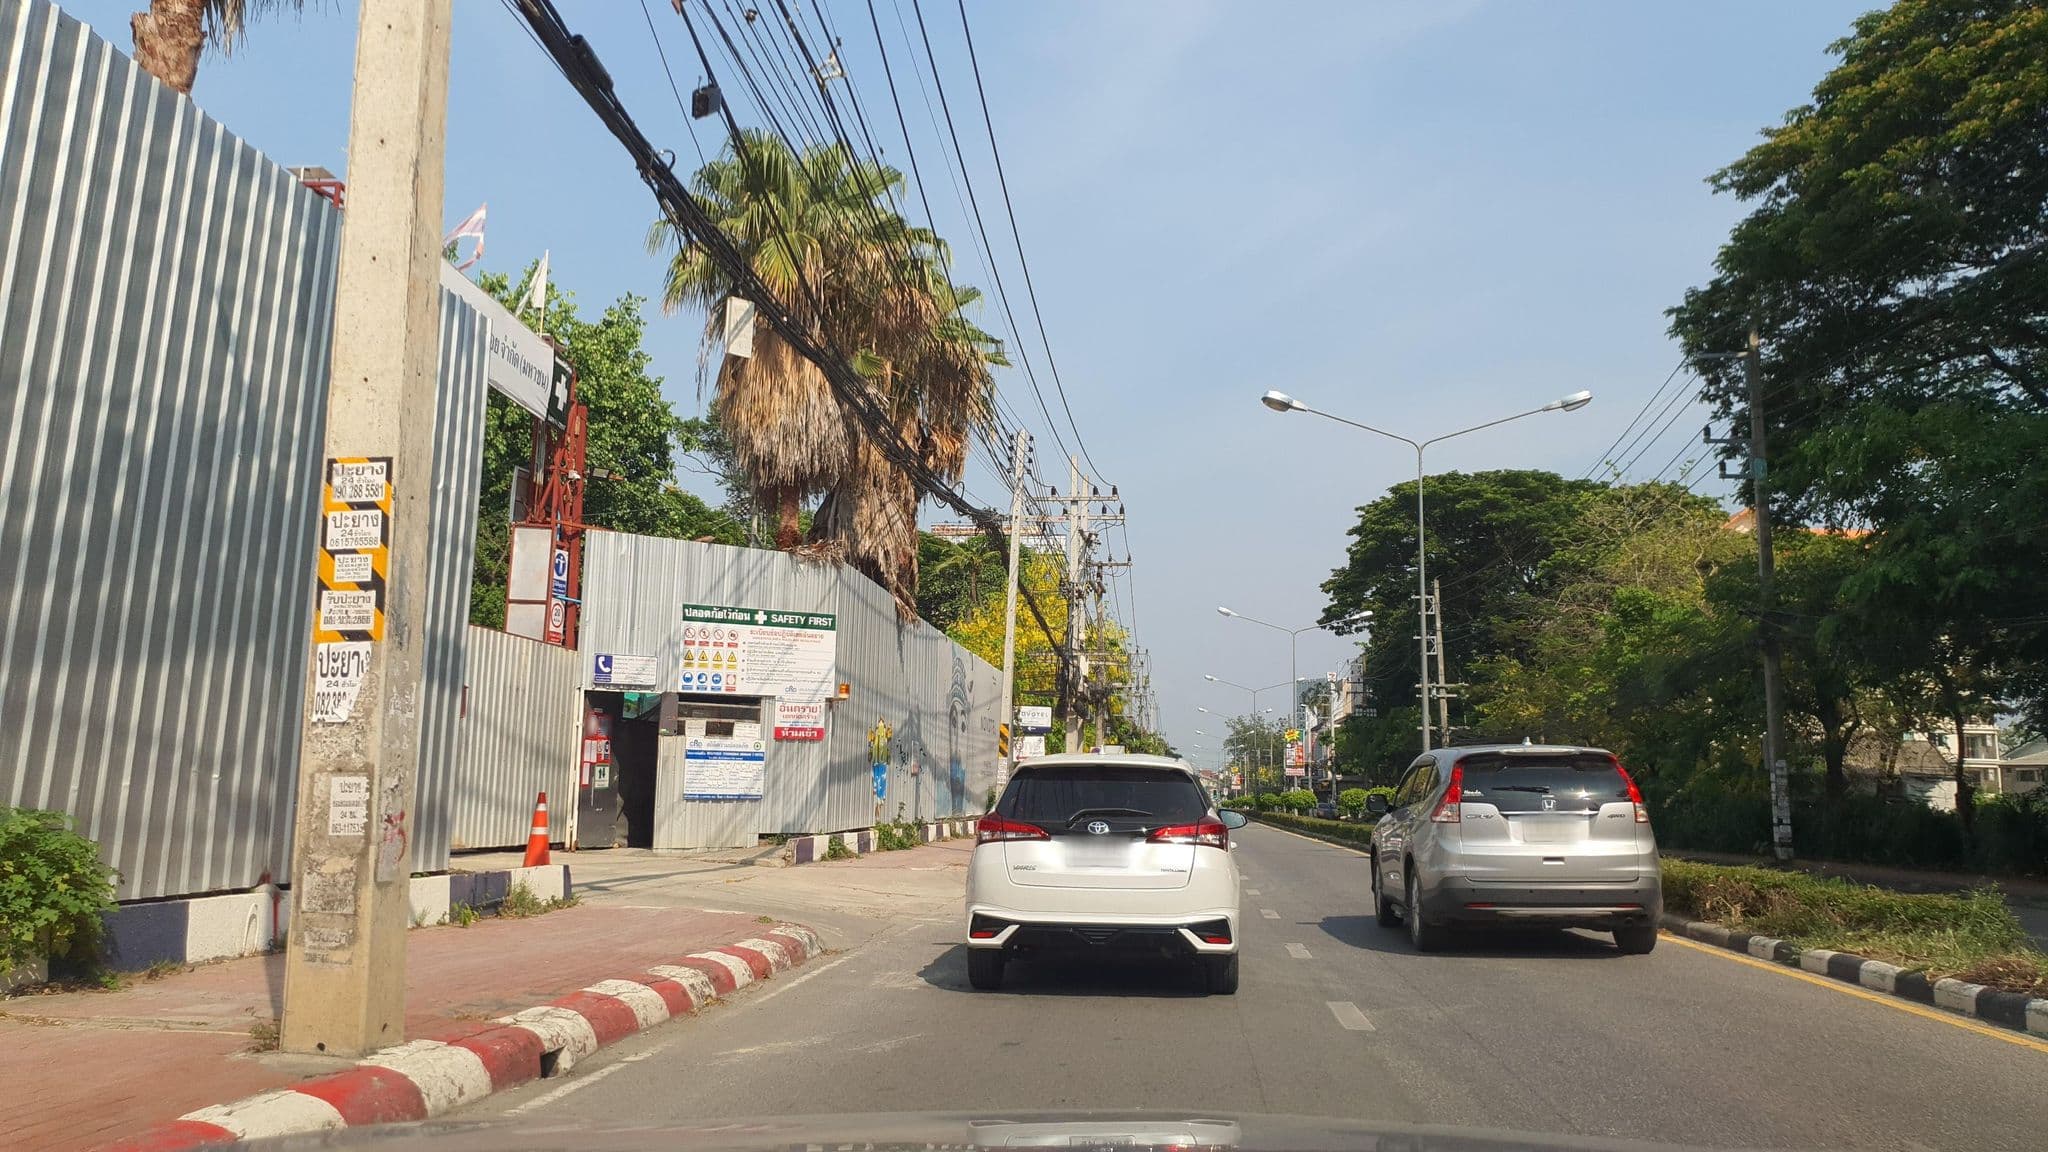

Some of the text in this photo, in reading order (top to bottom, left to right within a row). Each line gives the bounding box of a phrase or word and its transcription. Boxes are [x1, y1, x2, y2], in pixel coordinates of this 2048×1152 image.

[501, 334, 520, 368] จำกัด
[520, 355, 549, 392] (มหาชน)
[331, 512, 379, 529] ปะยาง
[340, 529, 354, 538] 24
[327, 591, 371, 605] รับปะยาง
[684, 607, 833, 627] ปลอดภัยไว้ก่อน SAFETY FIRST
[326, 680, 339, 688] 24
[779, 702, 822, 713] อันตราย!
[781, 728, 818, 737] ห้ามเข้า
